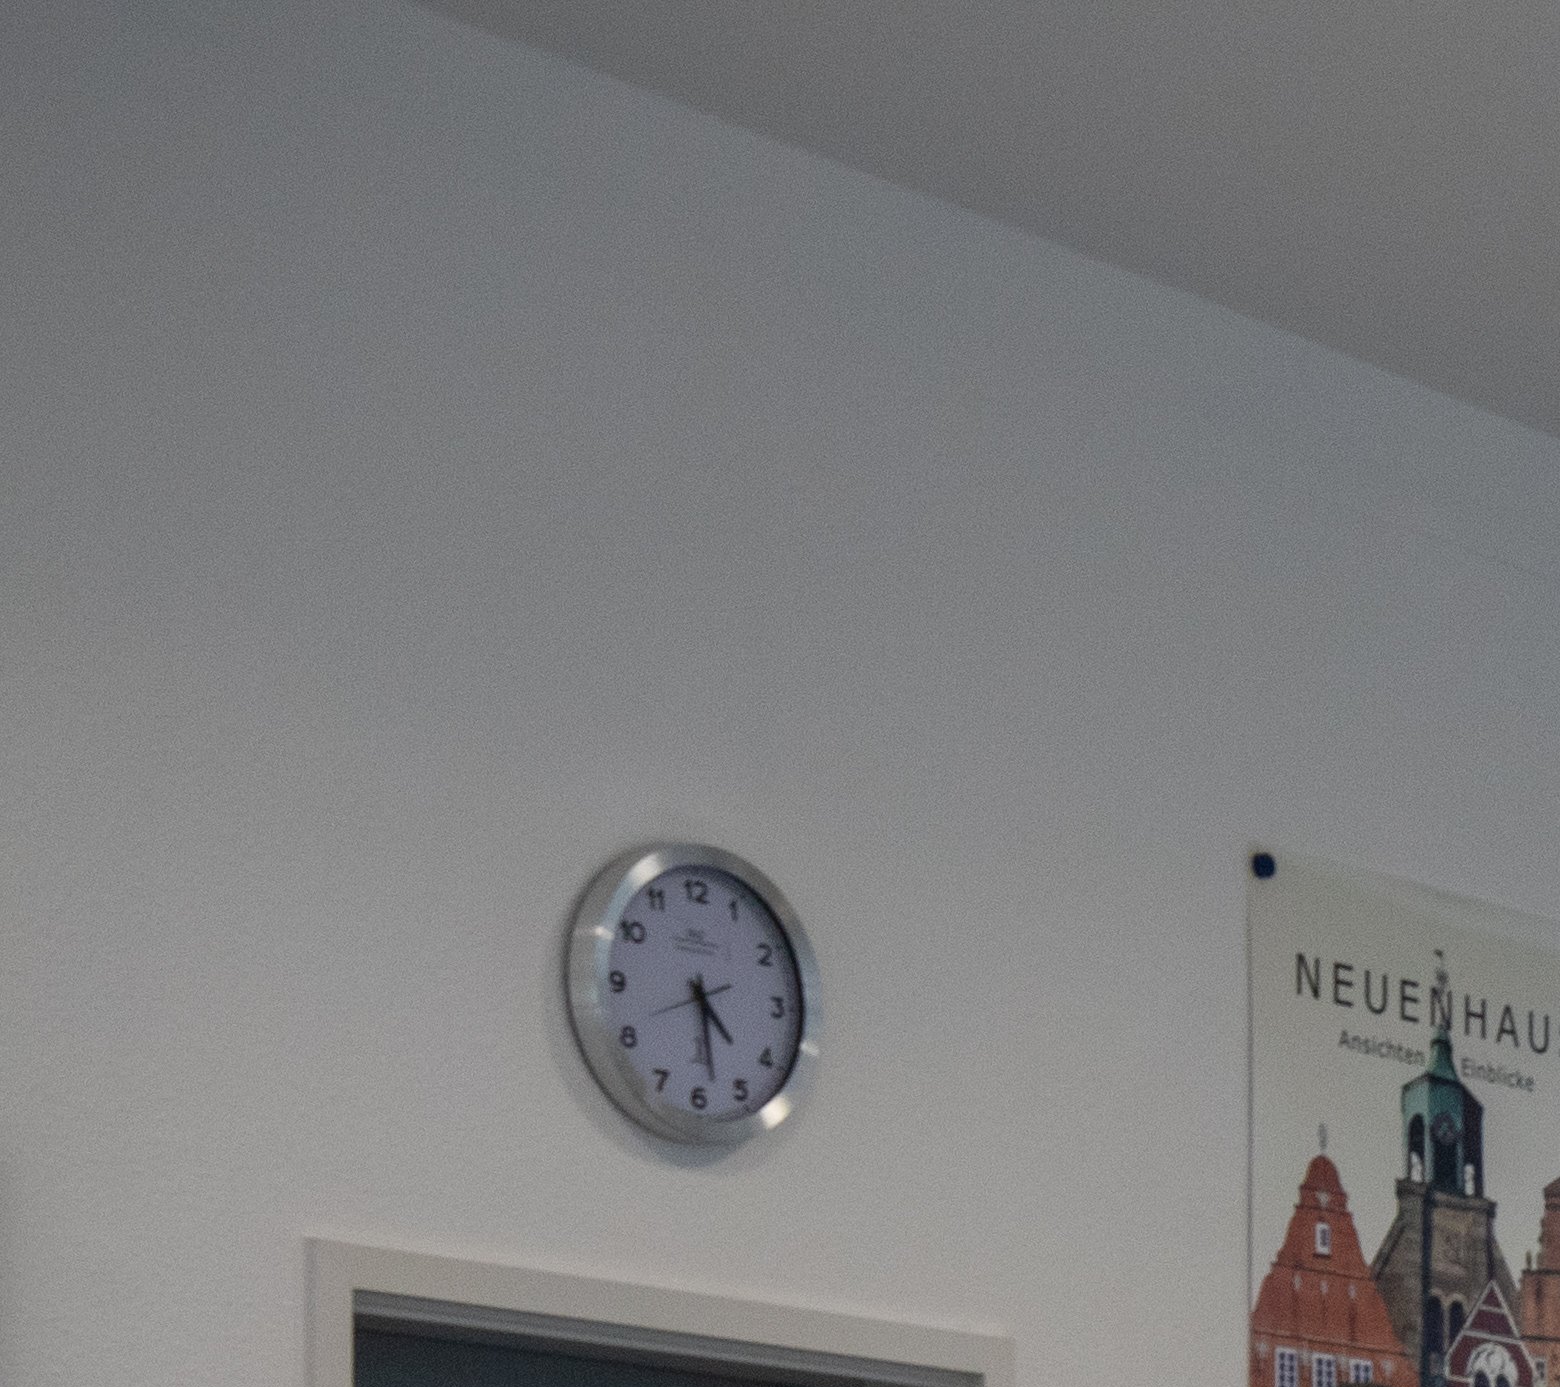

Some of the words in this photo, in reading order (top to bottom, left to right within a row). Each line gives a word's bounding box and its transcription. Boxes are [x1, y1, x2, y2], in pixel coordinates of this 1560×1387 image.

[647, 887, 666, 912] 11
[683, 879, 708, 905] 12
[728, 900, 739, 921] 1
[619, 919, 646, 944] 10
[756, 943, 774, 967] 2
[608, 970, 626, 993] 9
[770, 996, 785, 1019] 3
[620, 1025, 638, 1049] 8
[758, 1047, 774, 1069] 4
[1338, 1029, 1426, 1068] Ansichten
[1460, 1056, 1535, 1094] Einblicke
[653, 1067, 671, 1093] 7
[733, 1078, 750, 1102] 5
[690, 1086, 708, 1110] 6
